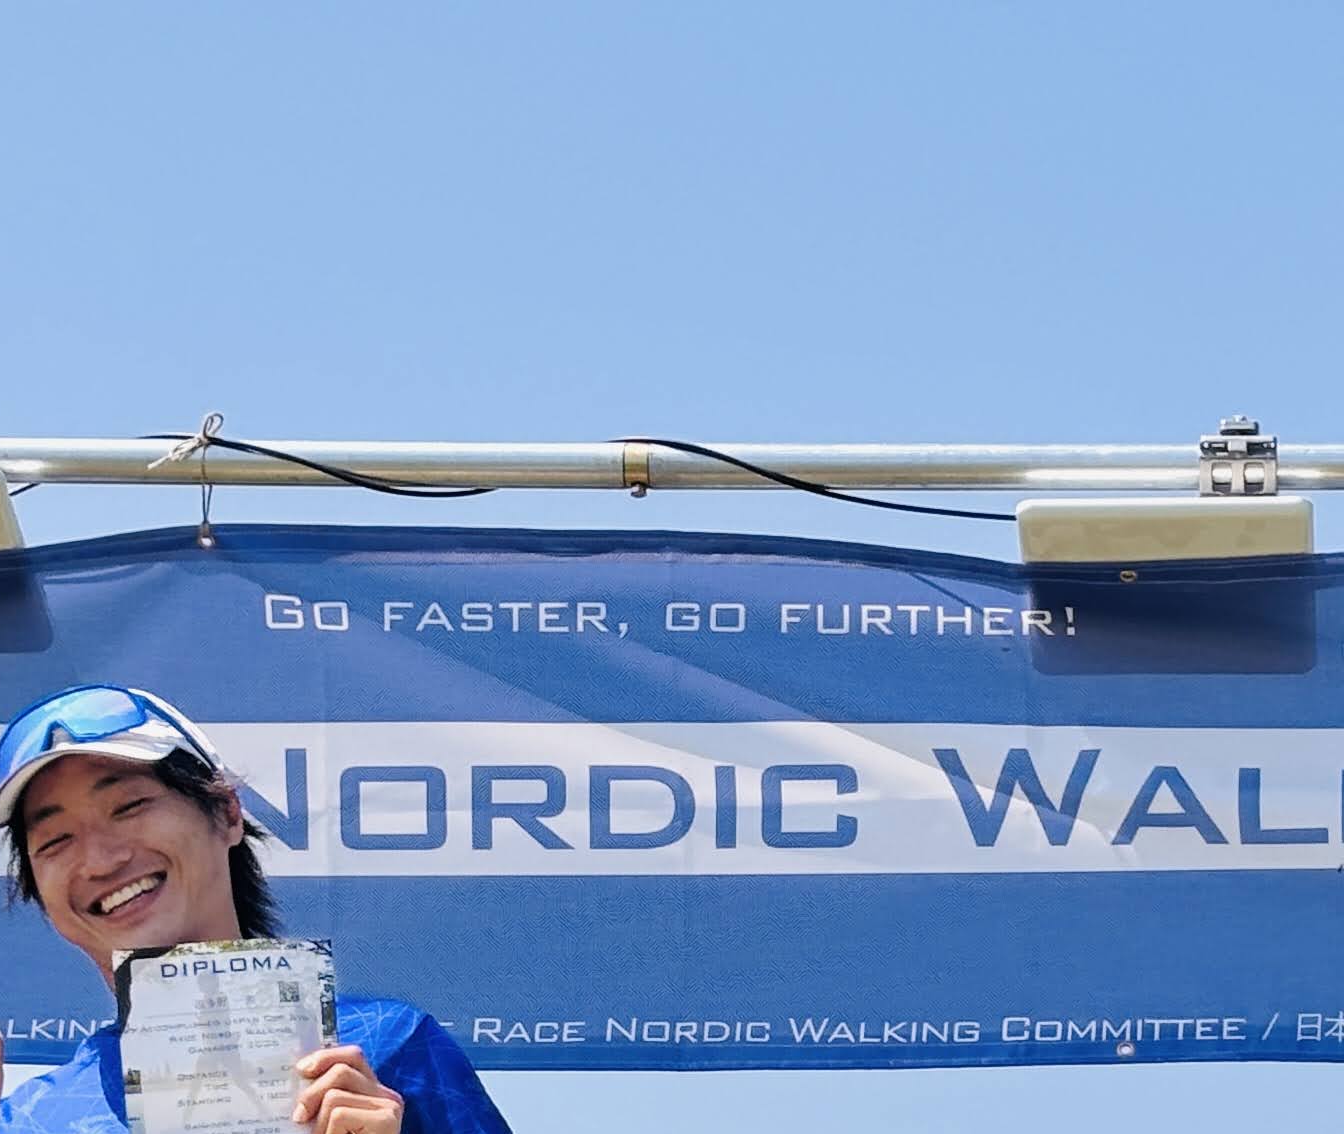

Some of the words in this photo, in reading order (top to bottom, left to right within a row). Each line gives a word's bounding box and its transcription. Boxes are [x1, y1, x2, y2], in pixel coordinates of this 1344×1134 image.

[264, 593, 351, 632] GO
[383, 600, 631, 638] FASTER,
[664, 600, 747, 634] GO
[778, 603, 1077, 638] FURTHER!
[160, 956, 292, 978] DIPLOMA
[472, 1017, 585, 1044] RACE
[606, 1017, 771, 1044] NORDIC
[790, 1017, 981, 1044] WALKING
[1001, 1015, 1245, 1043] COMMITTEE
